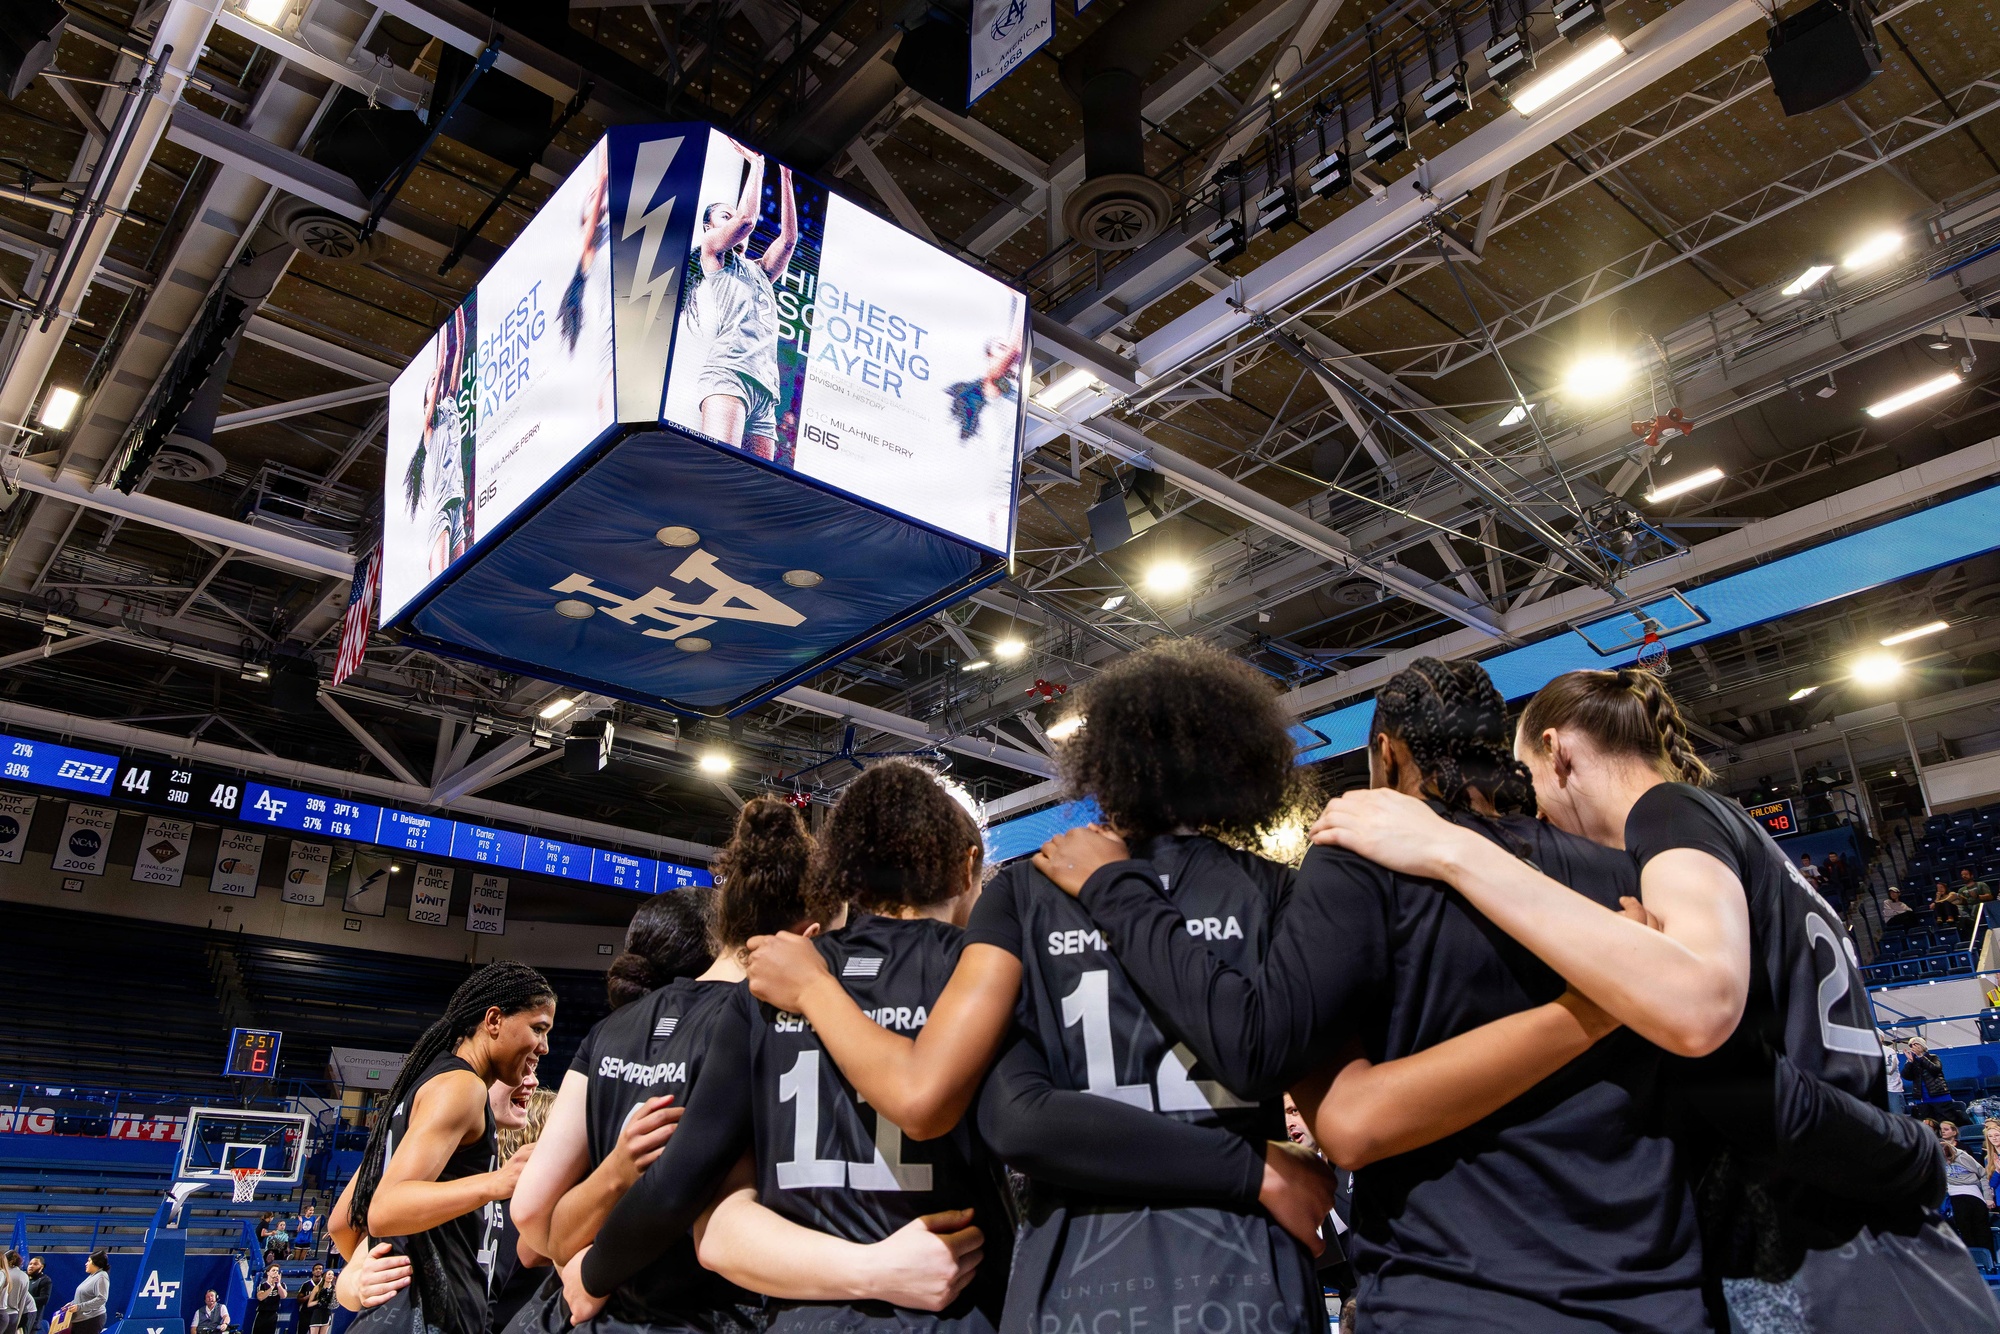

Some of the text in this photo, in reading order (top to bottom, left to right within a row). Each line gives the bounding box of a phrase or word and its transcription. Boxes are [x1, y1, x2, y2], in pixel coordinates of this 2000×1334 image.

[1000, 48, 1023, 73] 1968
[974, 67, 993, 81] ALL
[780, 269, 928, 349] HIGHEST
[459, 280, 542, 391] HIGHEST
[777, 291, 930, 381] SCORING
[458, 310, 546, 420] SCORING
[809, 373, 845, 397] DIVISION
[851, 393, 886, 411] HISTORY
[459, 357, 530, 442] PLAYER
[520, 421, 541, 447] PERRY
[668, 421, 719, 444] DAKTRONICS
[803, 423, 840, 451] 1615
[830, 417, 880, 446] MILAHNIE
[882, 439, 914, 459] PERRY
[477, 480, 498, 511] 1615
[12, 742, 33, 758] 21%
[4, 762, 30, 778] 38%
[57, 759, 114, 784] GCU
[170, 769, 192, 784] 2:51
[121, 767, 151, 794] 44
[1, 795, 22, 805] AIR
[167, 789, 189, 803] 3RD
[210, 783, 238, 810] 48
[254, 789, 287, 821] AF
[306, 797, 326, 812] 38%
[1750, 803, 1783, 818] FALCONS
[81, 808, 103, 818] AIR
[67, 816, 113, 830] FORCE
[159, 821, 180, 831] AIR
[303, 816, 322, 831] 37%
[1769, 815, 1789, 830] 48
[146, 828, 189, 841] FORCE
[233, 834, 253, 843] AIR
[407, 826, 427, 838] PTS 2
[71, 837, 99, 849] NCAA
[221, 840, 262, 853] FORCE
[302, 845, 320, 854] AIR
[405, 838, 417, 848] FLS
[478, 840, 501, 852] PTS 2
[539, 841, 561, 853] 2 Perry
[291, 850, 329, 863] FORCE
[476, 851, 487, 861] FLS
[546, 852, 570, 864] PTS 20
[604, 853, 610, 862] 13
[63, 859, 96, 871] 2006
[545, 863, 555, 873] FLS
[614, 865, 640, 878] PTS 9
[675, 867, 692, 877] Adams
[144, 871, 173, 882] 2007
[427, 867, 443, 878] AIR
[222, 883, 245, 893] 2011
[417, 876, 449, 890] FORCE
[483, 877, 498, 888] AIR
[613, 876, 639, 888] FLS 2
[676, 877, 687, 886] PTS
[290, 892, 315, 902] 2013
[415, 893, 446, 907] WNIT
[473, 886, 504, 900] FORCE
[415, 910, 441, 923] 2022
[473, 903, 502, 917] WNIT
[472, 919, 498, 932] 2025
[251, 1049, 267, 1072] 6
[344, 1055, 400, 1068] CommonSpirit
[776, 1049, 933, 1191] 11
[138, 1269, 180, 1310] AF
[1060, 1272, 1272, 1300] UNITED STATES
[1172, 1300, 1304, 1334] FORC
